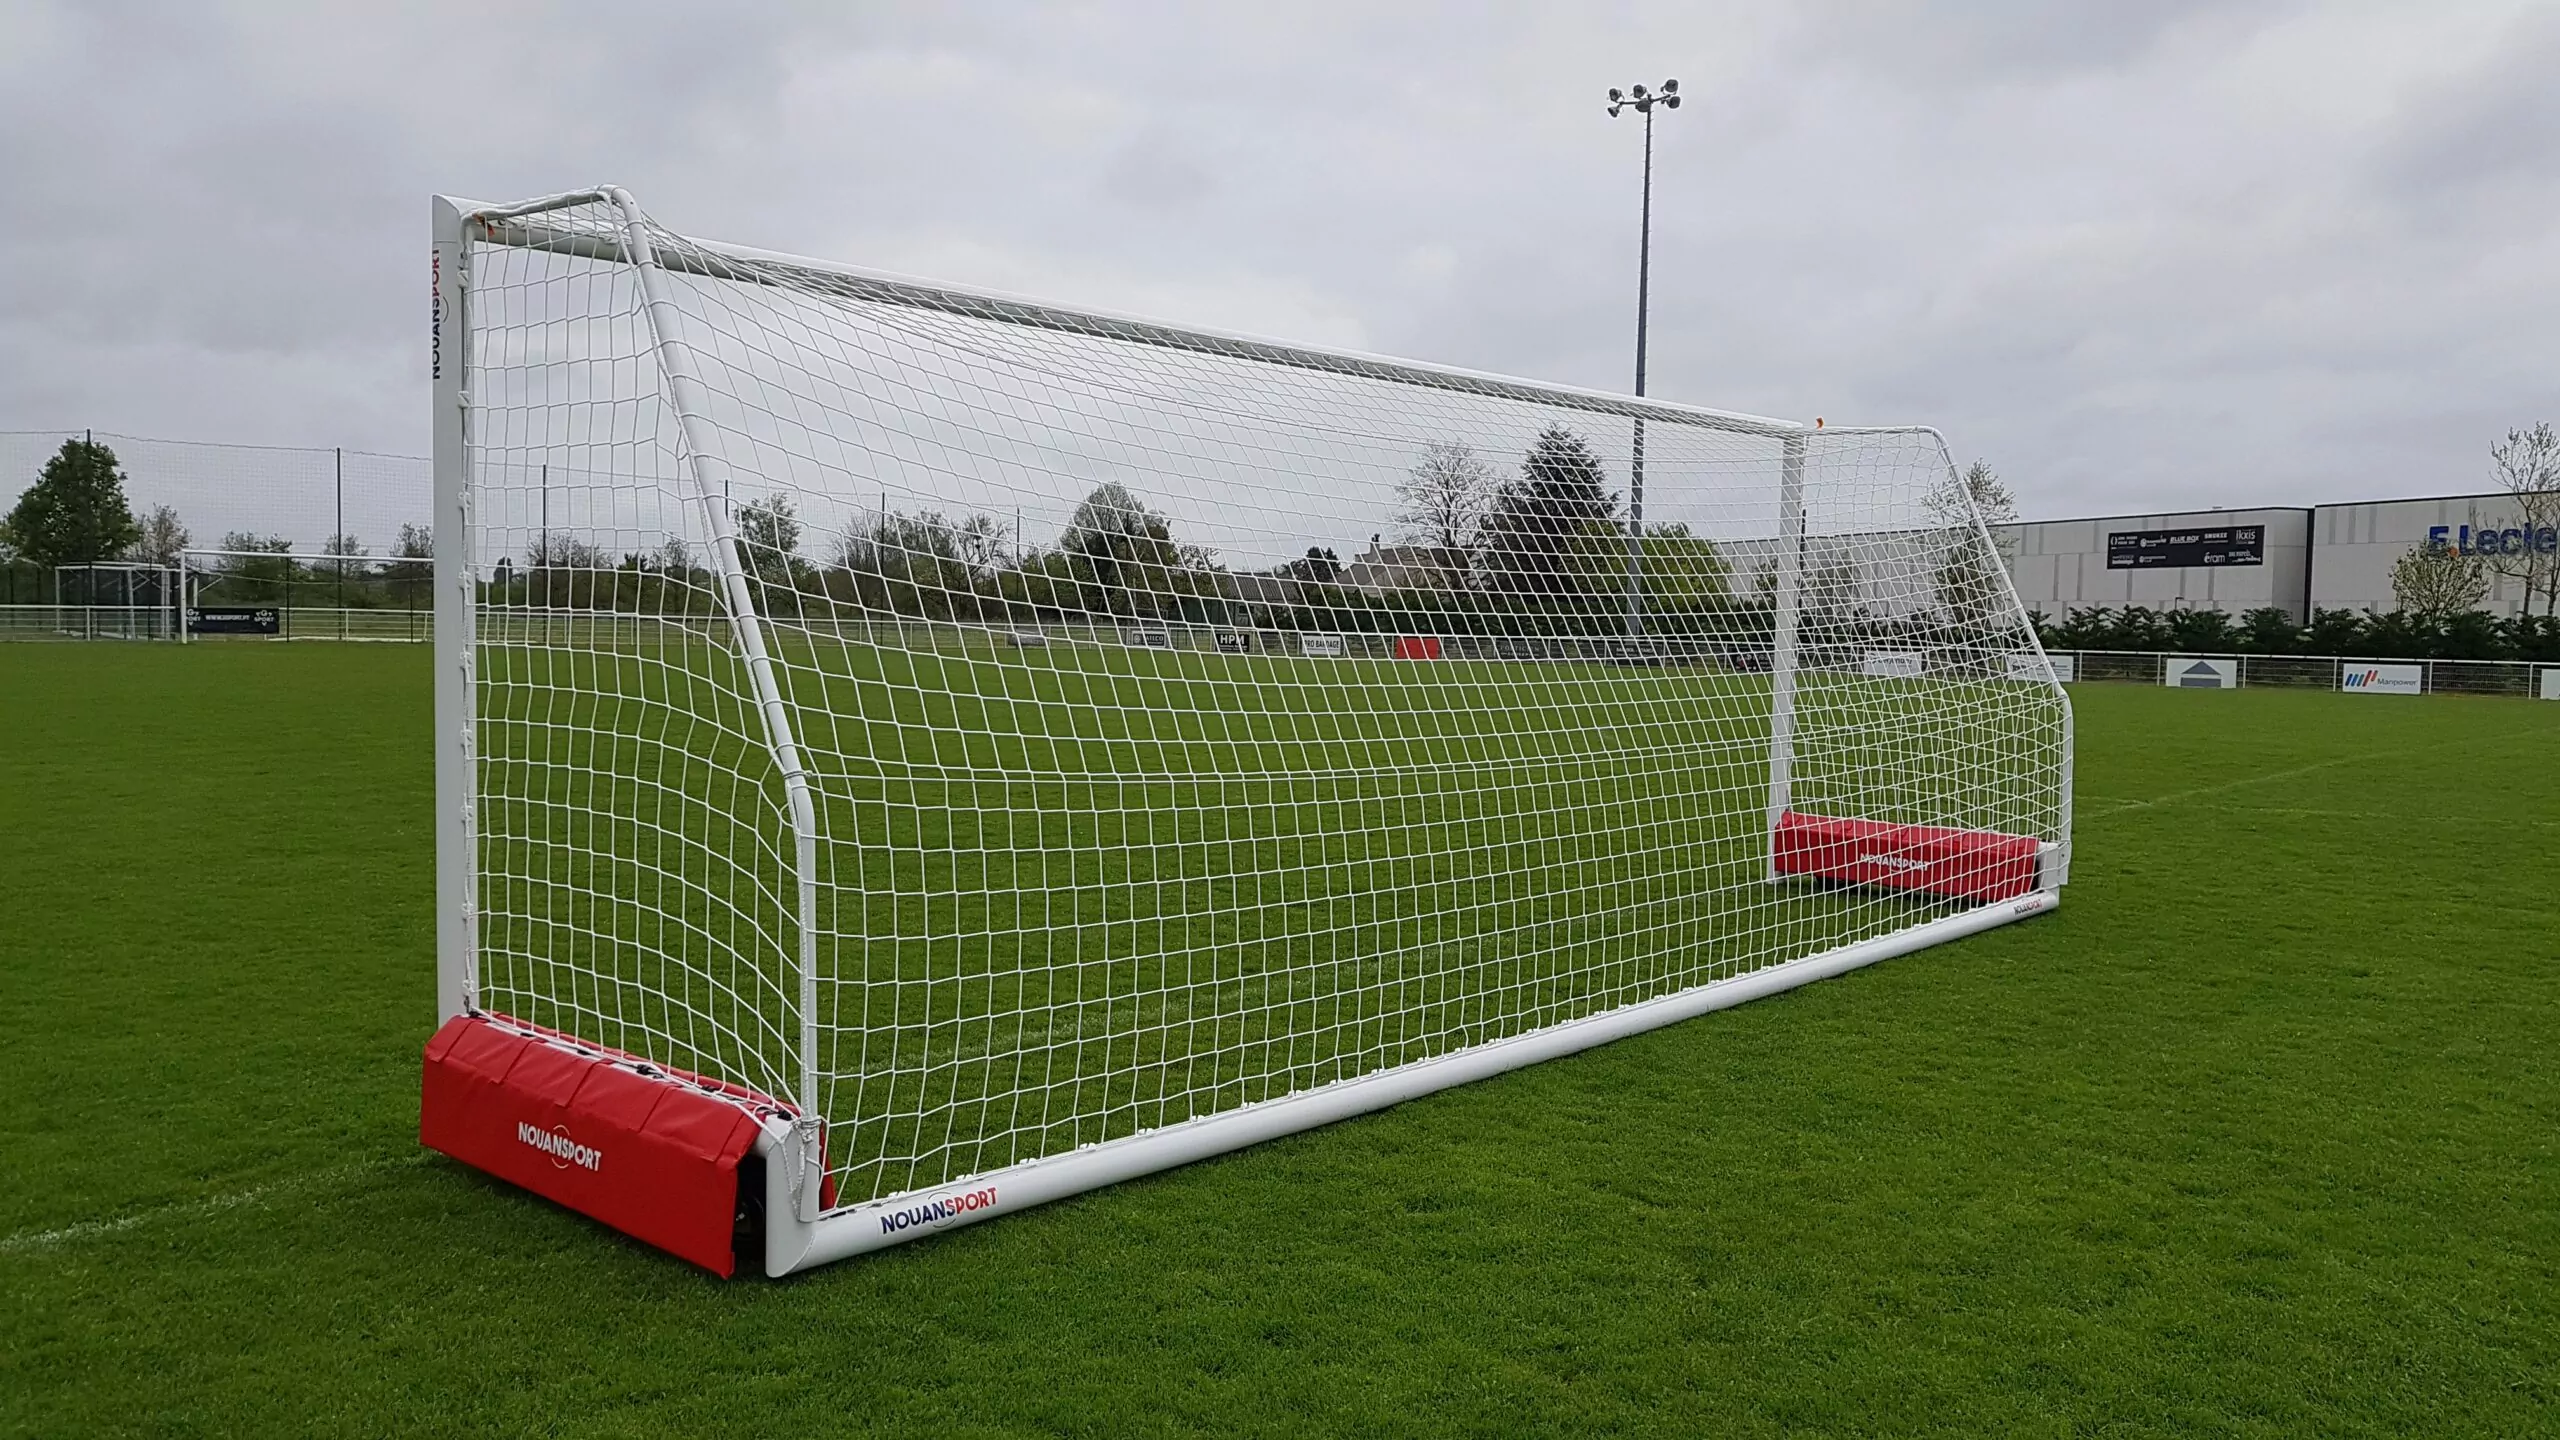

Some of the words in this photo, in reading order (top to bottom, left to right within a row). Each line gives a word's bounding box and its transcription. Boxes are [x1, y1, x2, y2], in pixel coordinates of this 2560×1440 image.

[1220, 634, 1245, 645] HPM
[2377, 678, 2417, 687] Manpower
[518, 1121, 602, 1171] NOUANSPORT
[880, 1187, 997, 1234] NOUANSPORT
